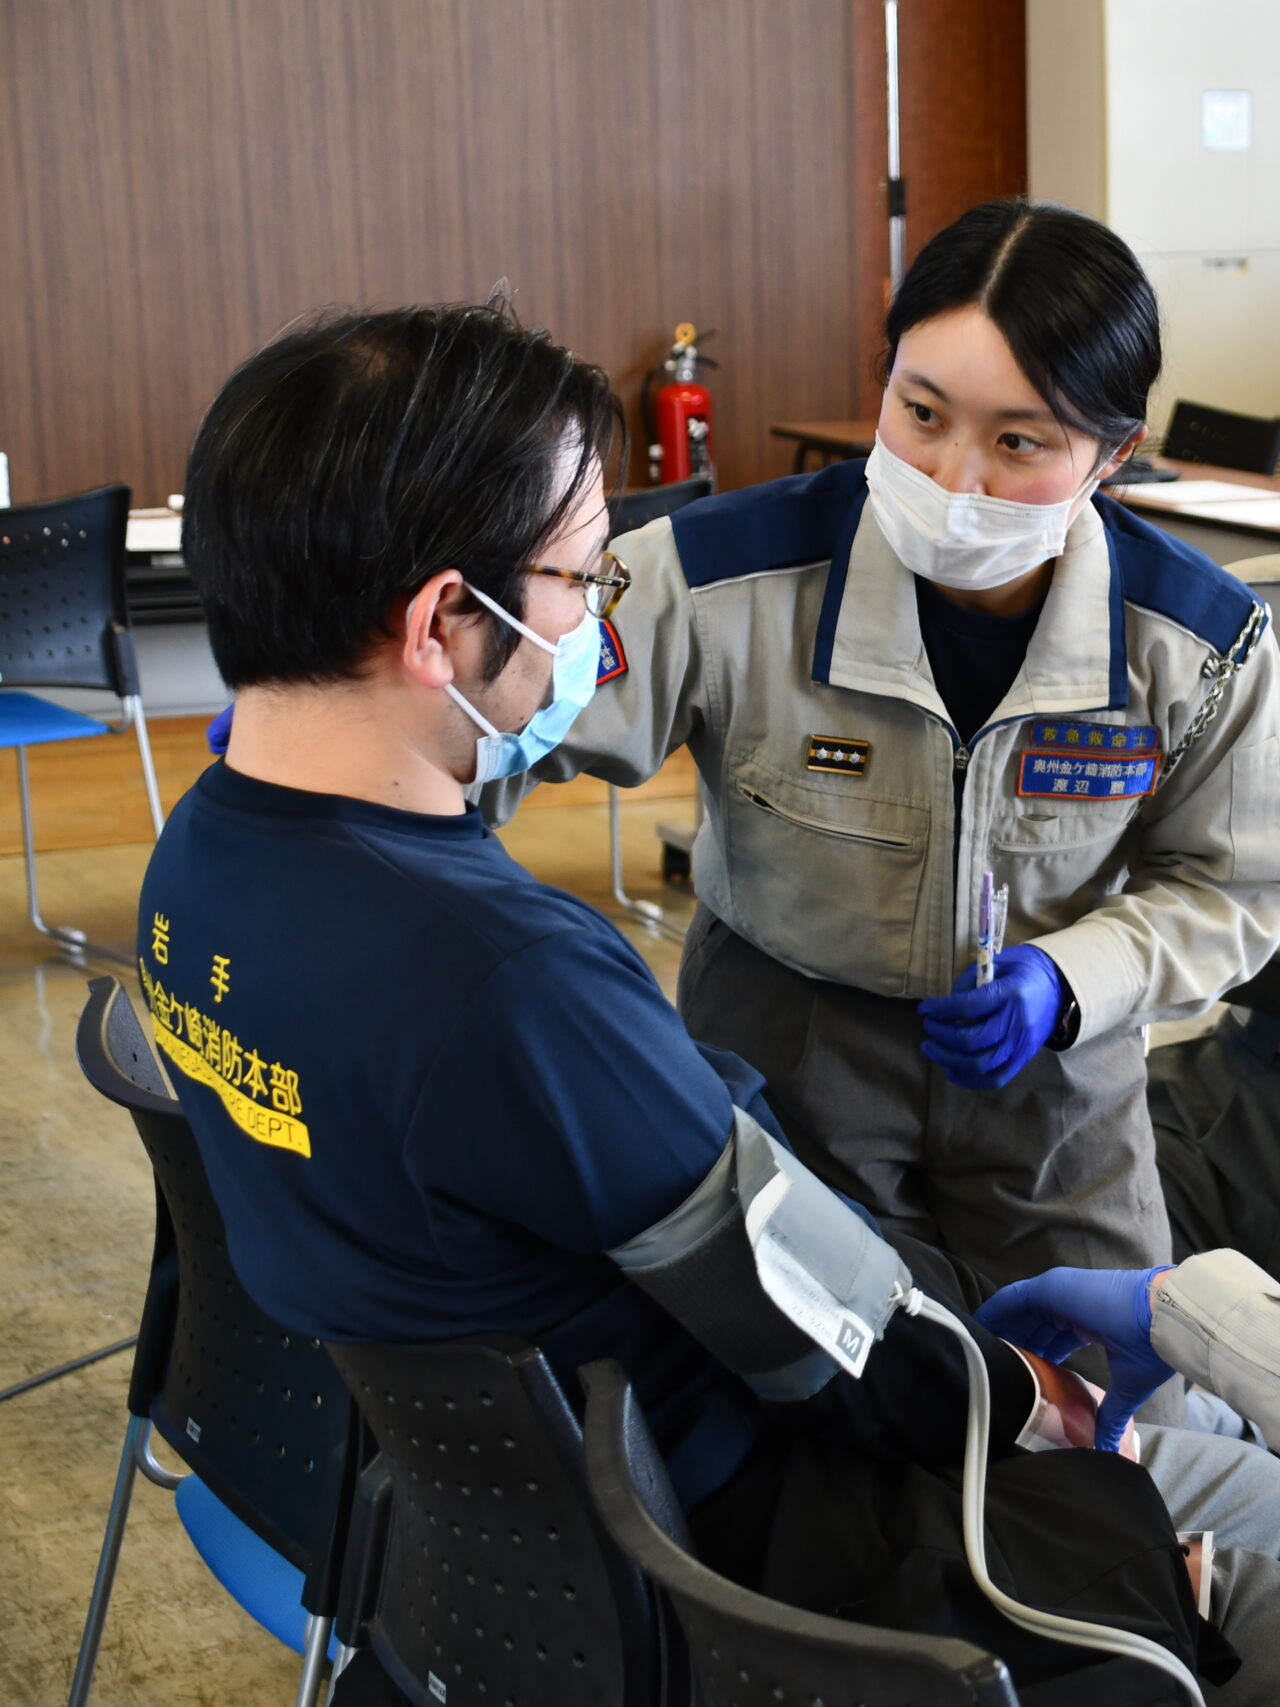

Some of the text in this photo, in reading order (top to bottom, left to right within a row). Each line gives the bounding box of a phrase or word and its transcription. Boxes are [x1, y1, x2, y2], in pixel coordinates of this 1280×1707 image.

[1043, 726, 1149, 748] 救急救命士
[842, 1327, 860, 1355] M
